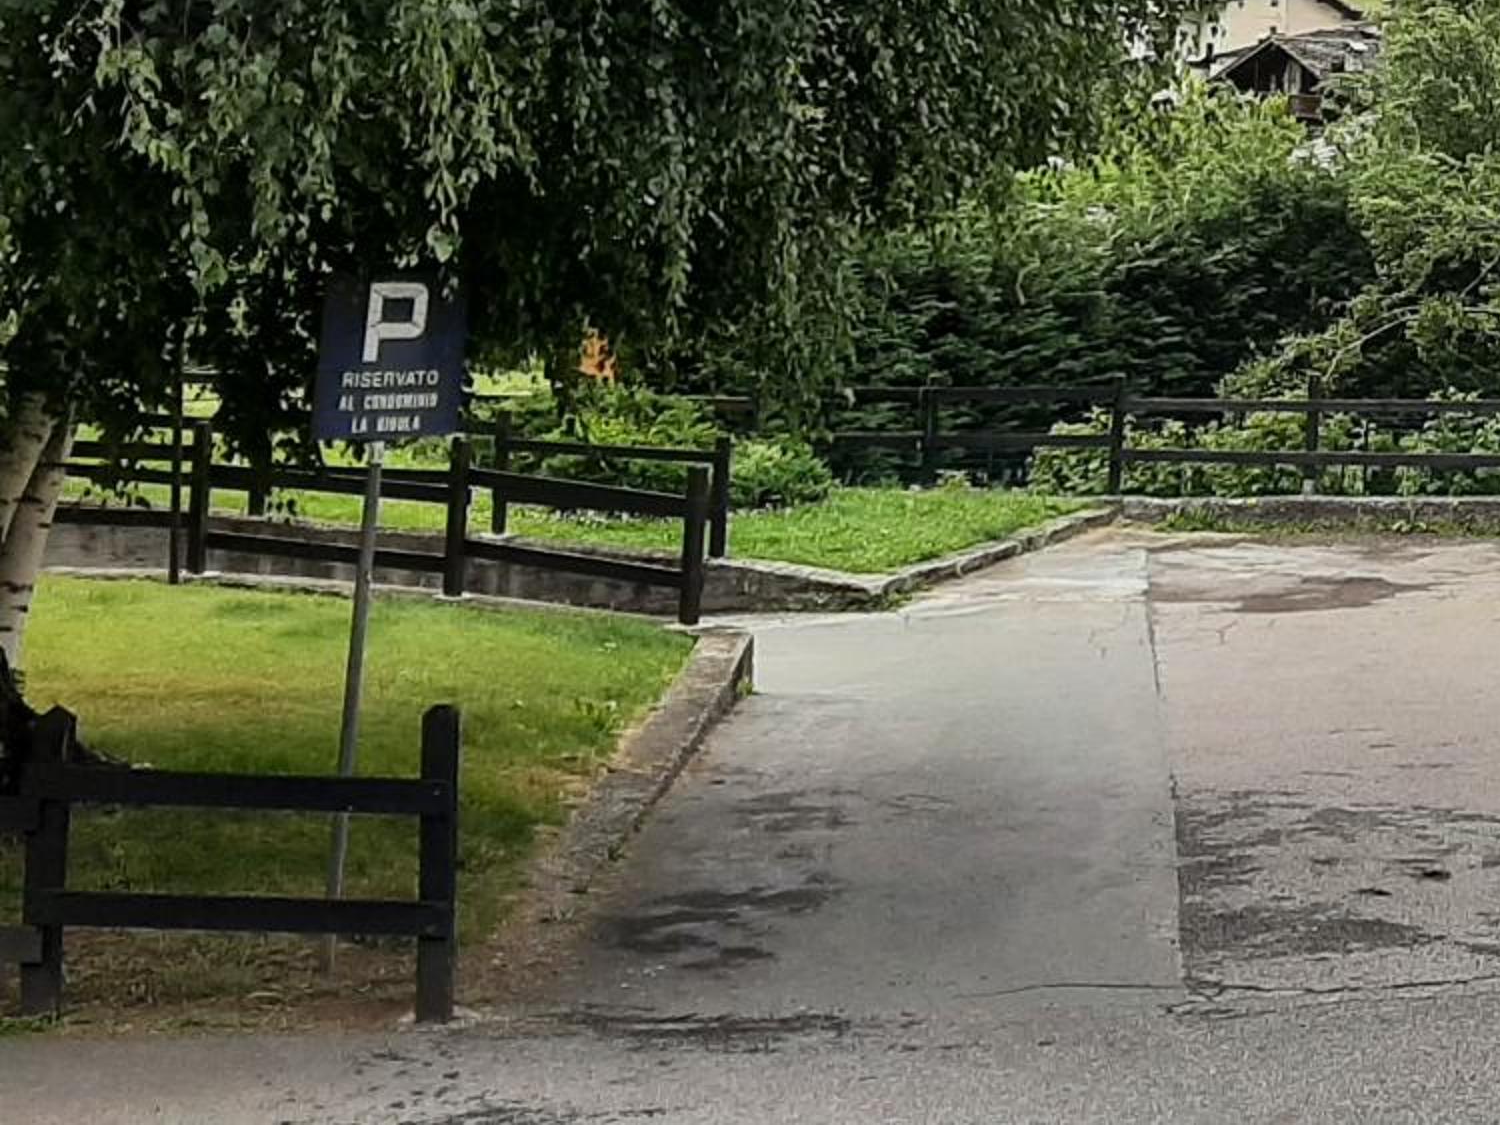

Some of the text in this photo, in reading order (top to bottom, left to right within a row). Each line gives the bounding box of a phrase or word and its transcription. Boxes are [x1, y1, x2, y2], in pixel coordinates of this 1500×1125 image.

[362, 282, 428, 363] P
[342, 370, 439, 388] RISERVATO
[338, 394, 353, 411] AL
[351, 416, 367, 433] LA
